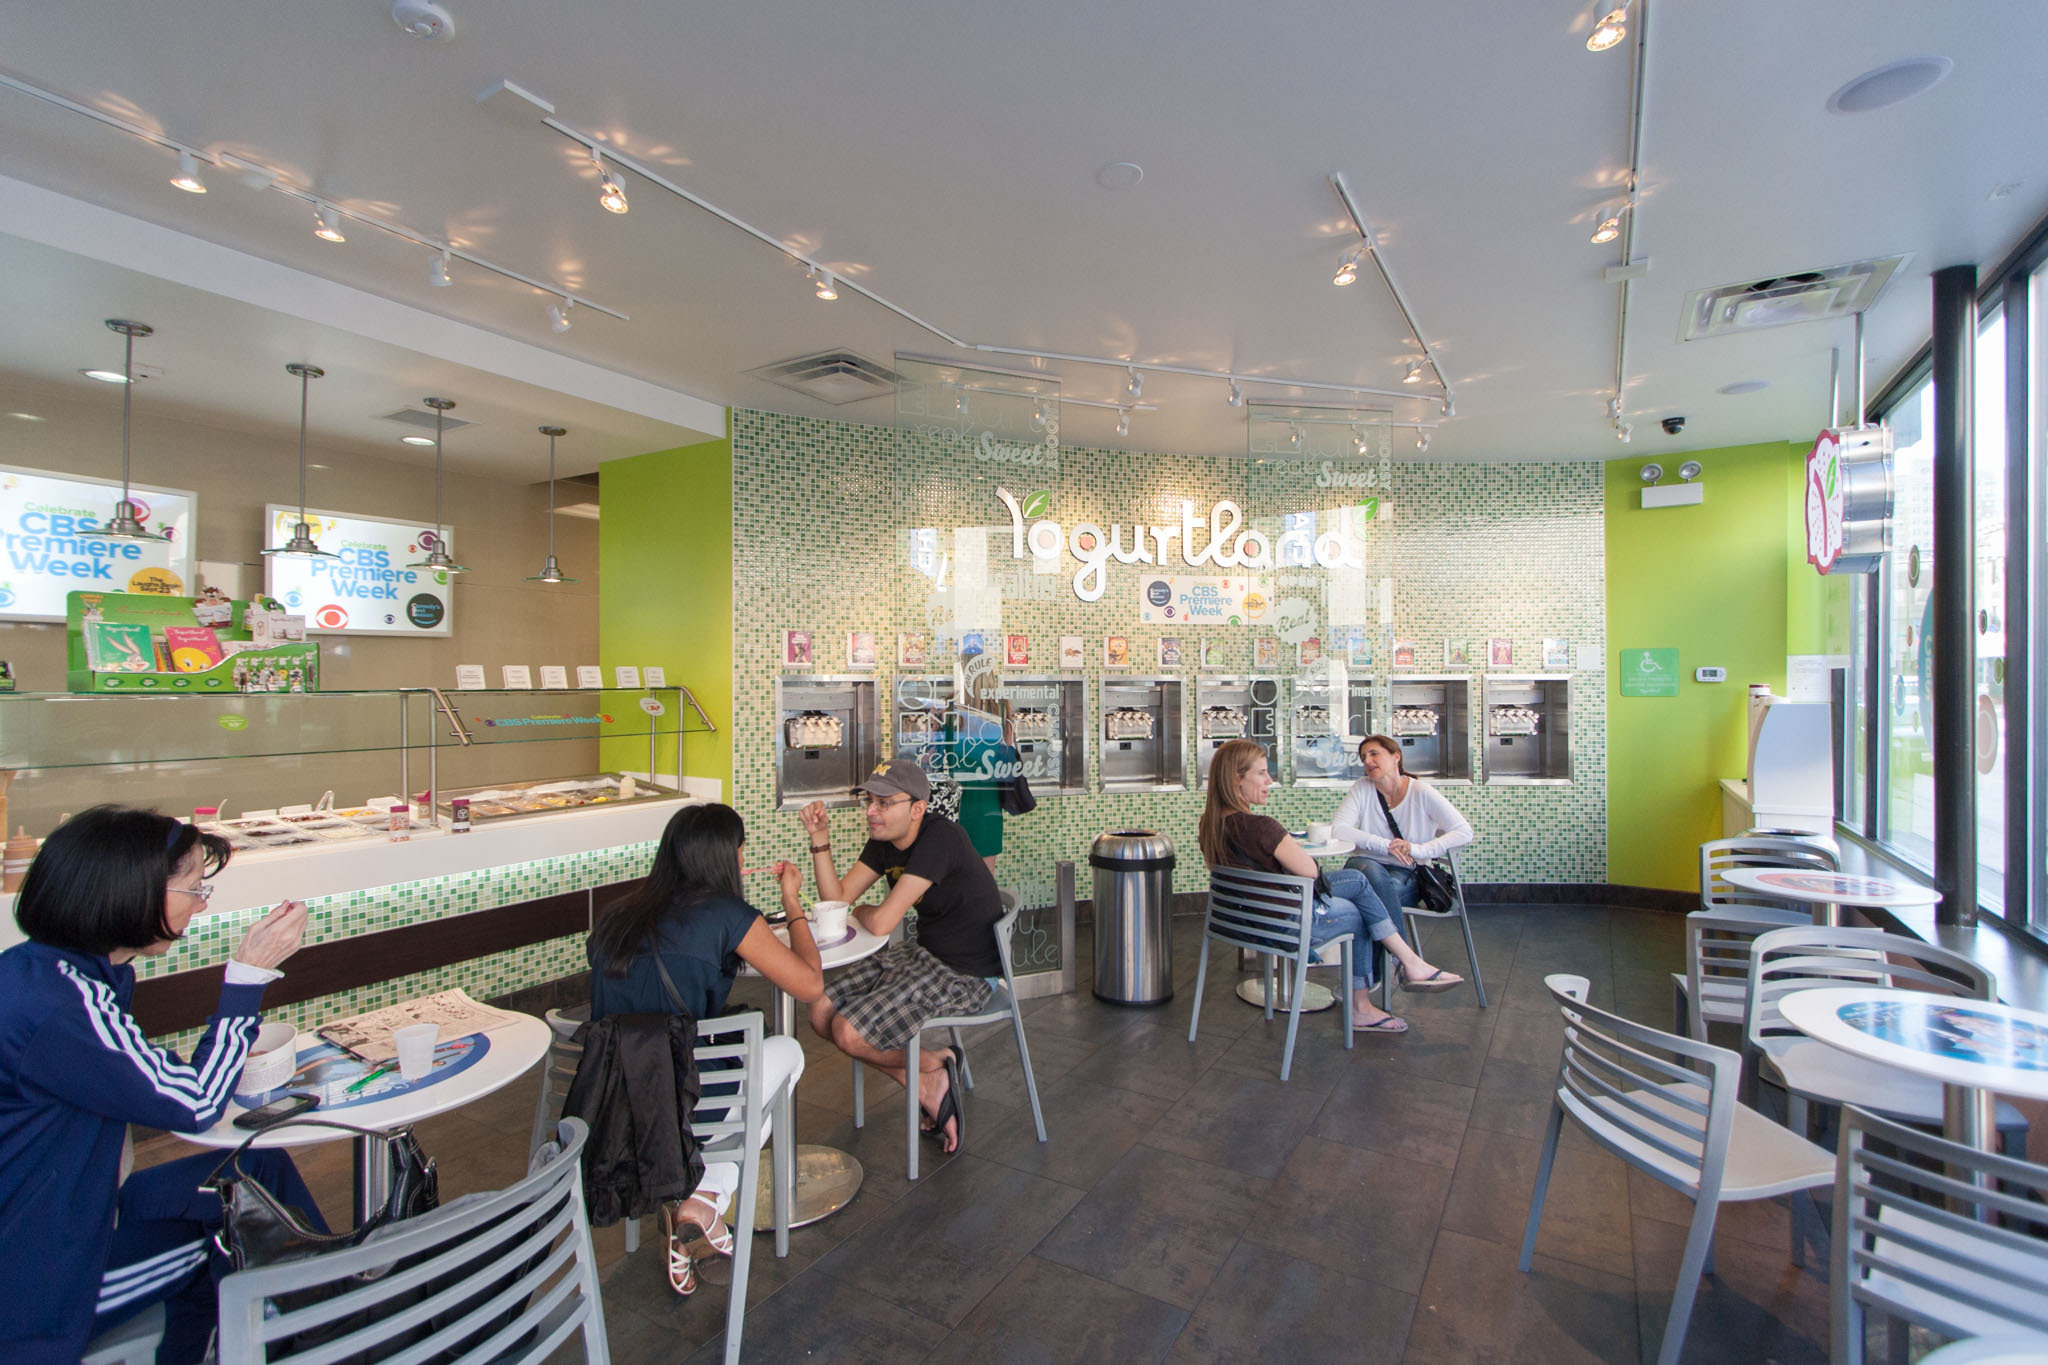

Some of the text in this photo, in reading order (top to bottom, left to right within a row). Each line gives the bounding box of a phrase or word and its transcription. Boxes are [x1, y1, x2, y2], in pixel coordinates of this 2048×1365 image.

[974, 431, 1044, 467] Sweet
[1316, 460, 1378, 488] Sweet
[24, 502, 96, 518] Celebrate
[19, 512, 99, 537] CBS
[0, 528, 142, 560] remiere
[341, 539, 387, 550] Celebrate
[995, 487, 1363, 602] Yogurtland
[8, 551, 113, 580] Week
[338, 547, 390, 568] CBS
[311, 559, 418, 584] Premiere
[332, 578, 400, 600] Week
[1179, 594, 1233, 606] Premiere
[1191, 585, 1218, 597] CBS
[1189, 605, 1223, 616] Week
[1277, 606, 1312, 633] Real
[968, 656, 993, 674] RULE
[980, 684, 1060, 703] experimental
[975, 749, 1046, 781] Sweet
[1012, 928, 1058, 968] ule
